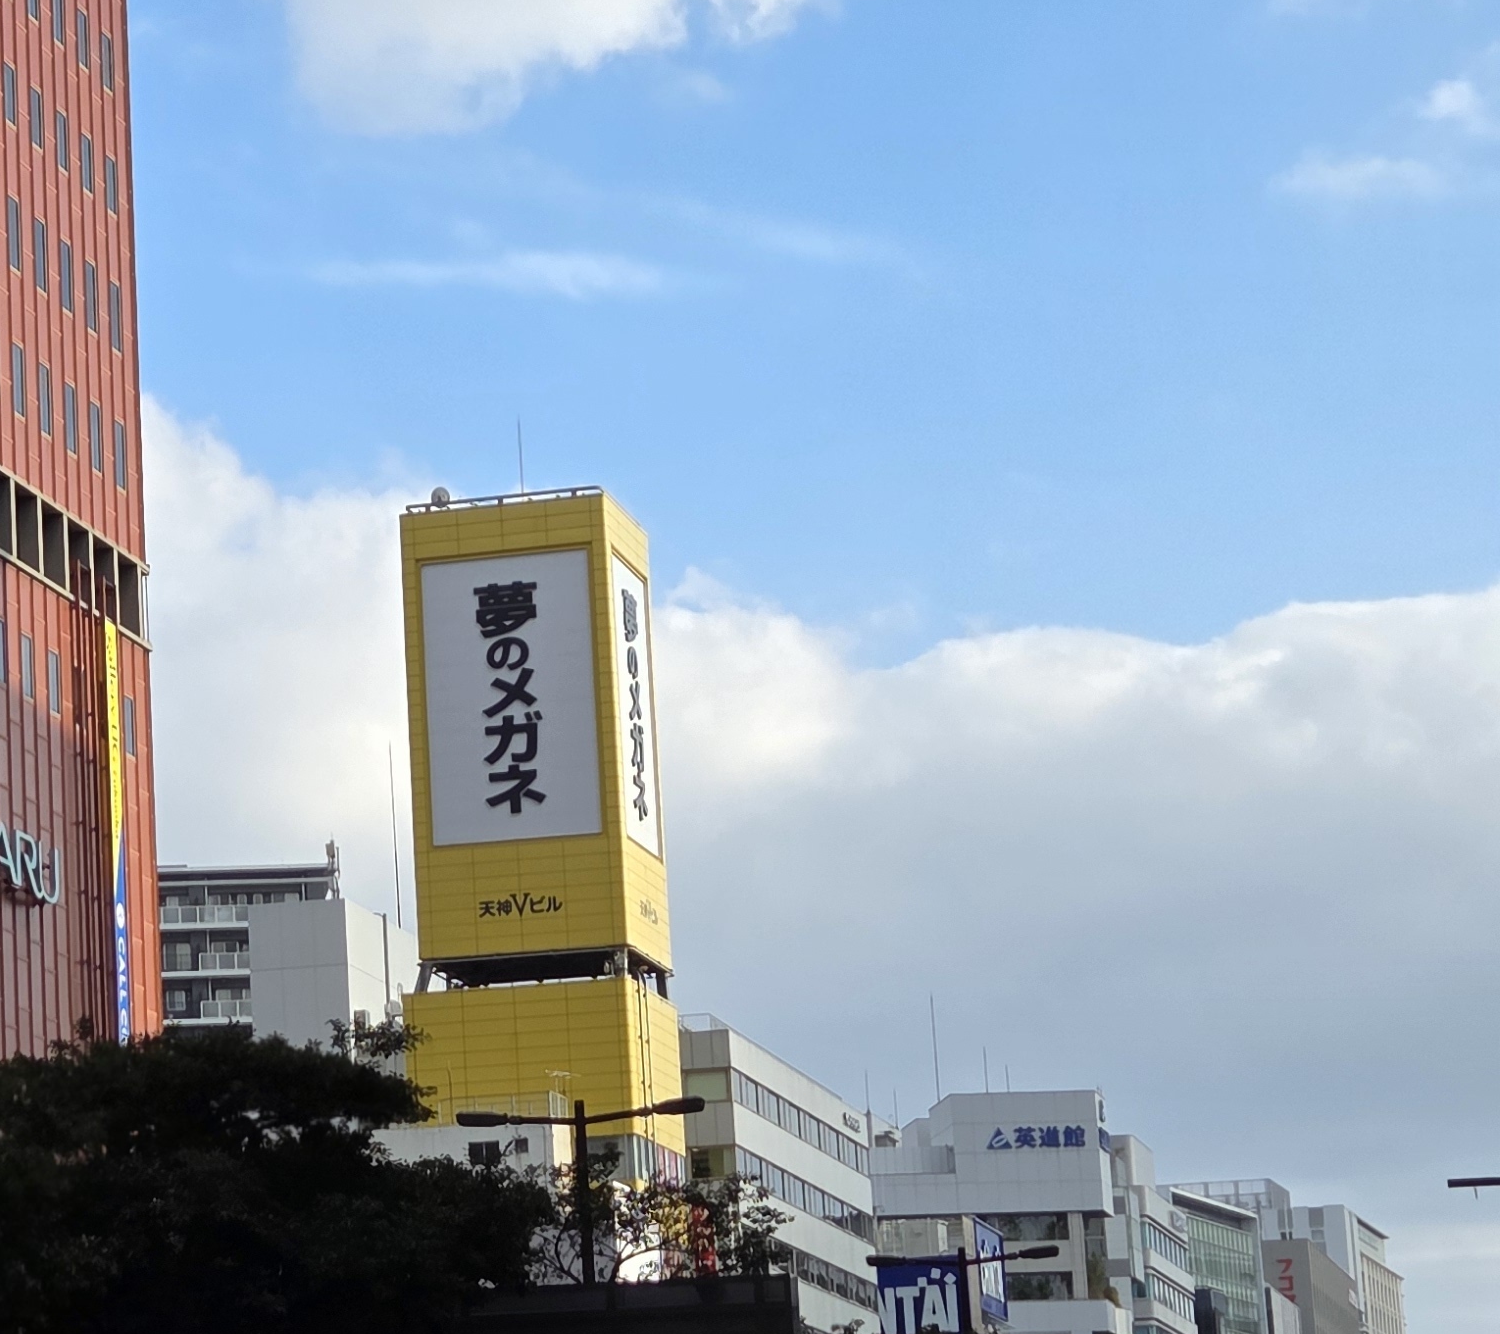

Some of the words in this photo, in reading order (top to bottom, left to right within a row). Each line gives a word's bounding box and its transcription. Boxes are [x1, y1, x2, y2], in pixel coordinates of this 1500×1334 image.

[473, 580, 548, 815] 夢のメガネ
[478, 892, 563, 919] 天神Vビル
[118, 936, 127, 1003] CALL
[1013, 1125, 1086, 1149] 英進館
